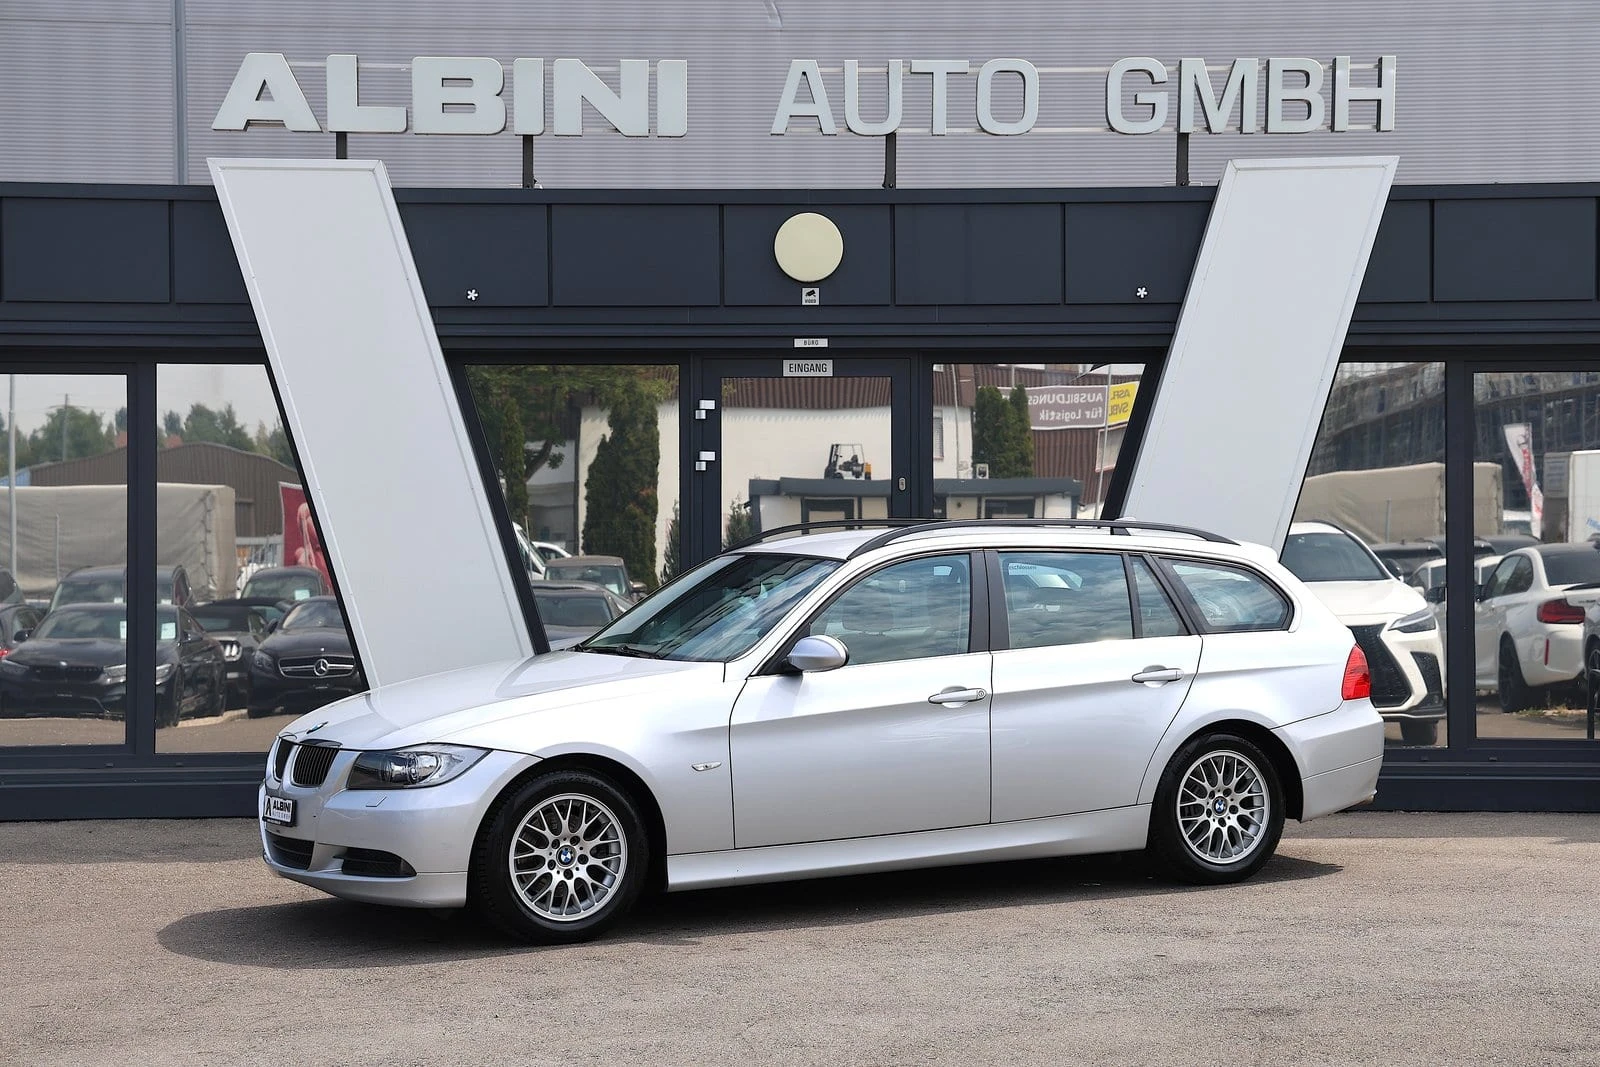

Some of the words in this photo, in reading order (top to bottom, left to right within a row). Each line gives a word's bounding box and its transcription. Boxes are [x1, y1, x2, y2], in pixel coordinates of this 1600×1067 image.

[211, 53, 688, 138] ALBINI
[770, 58, 1039, 136] AUTO
[1105, 55, 1397, 135] GMBH
[788, 362, 828, 373] EINGANG
[273, 799, 292, 813] ALBINI
